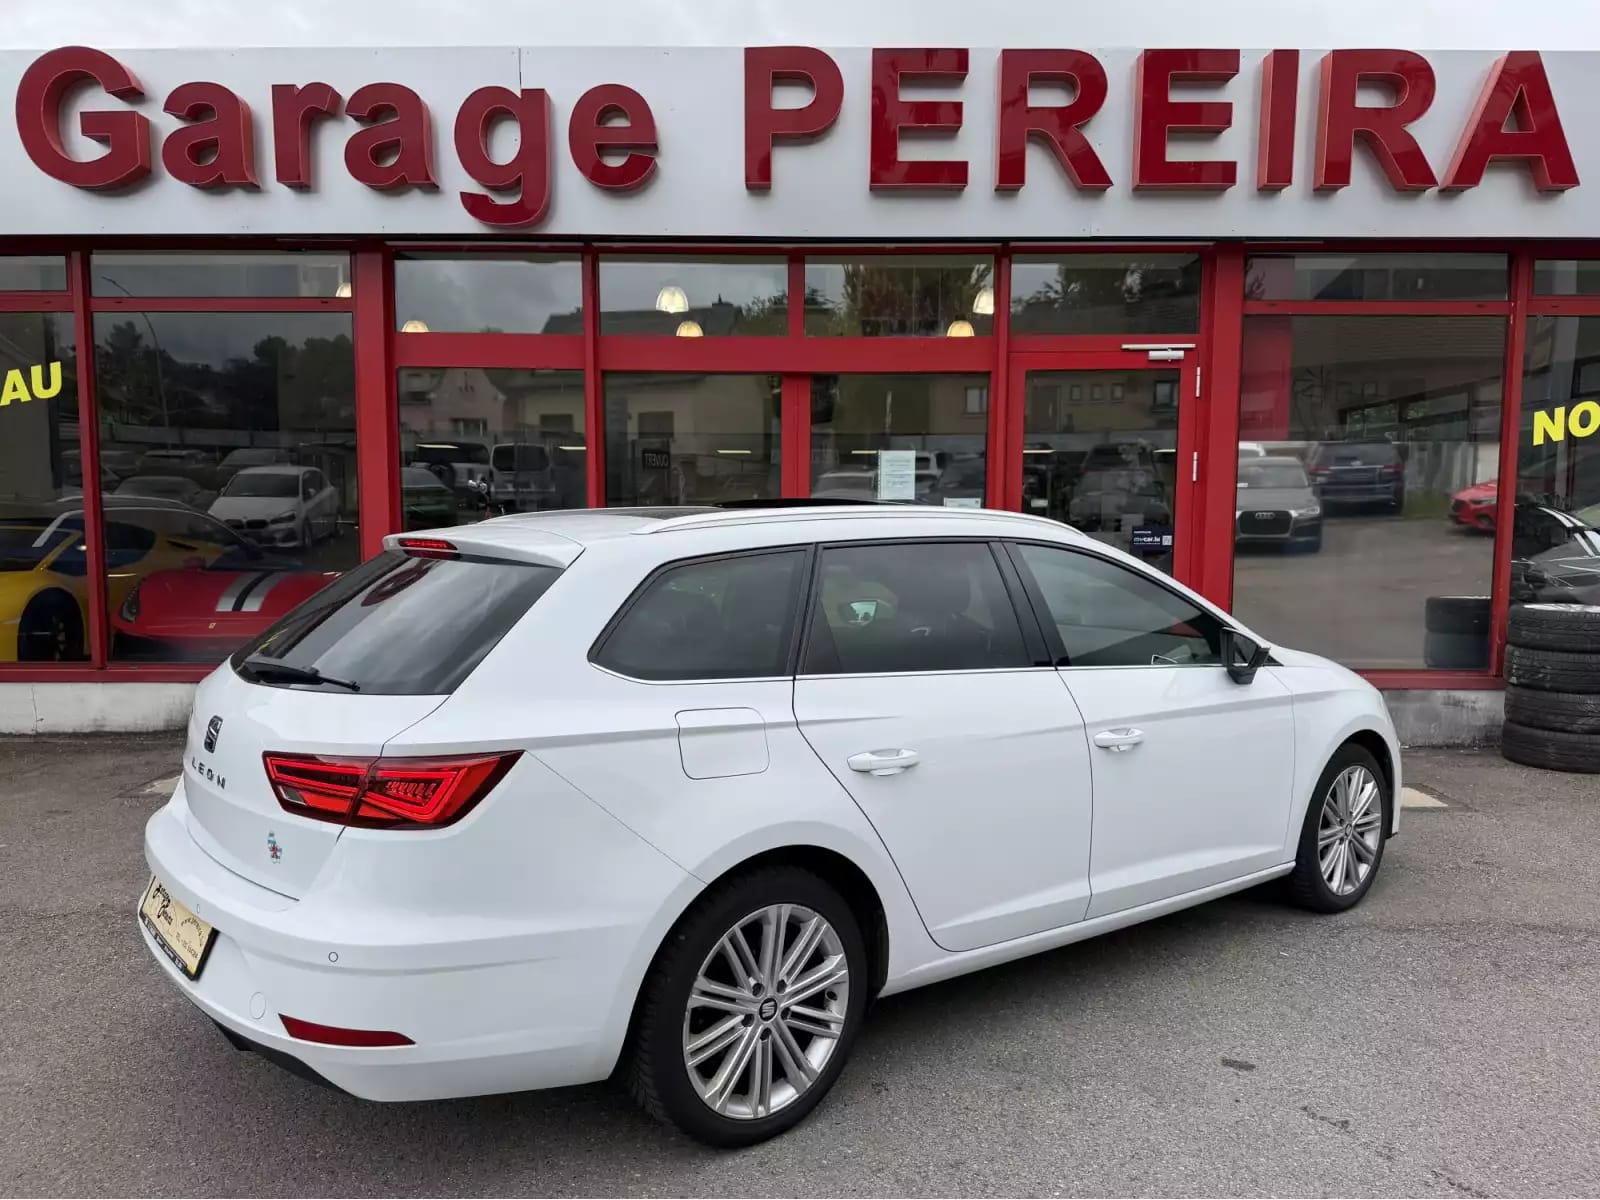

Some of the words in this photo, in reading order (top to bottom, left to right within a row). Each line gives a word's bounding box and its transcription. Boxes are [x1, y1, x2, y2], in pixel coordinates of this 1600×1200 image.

[15, 45, 659, 228] Garage
[744, 47, 1580, 192] PEREIRA
[0, 361, 62, 406] AU
[1533, 401, 1600, 446] NO
[191, 756, 227, 790] LEON
